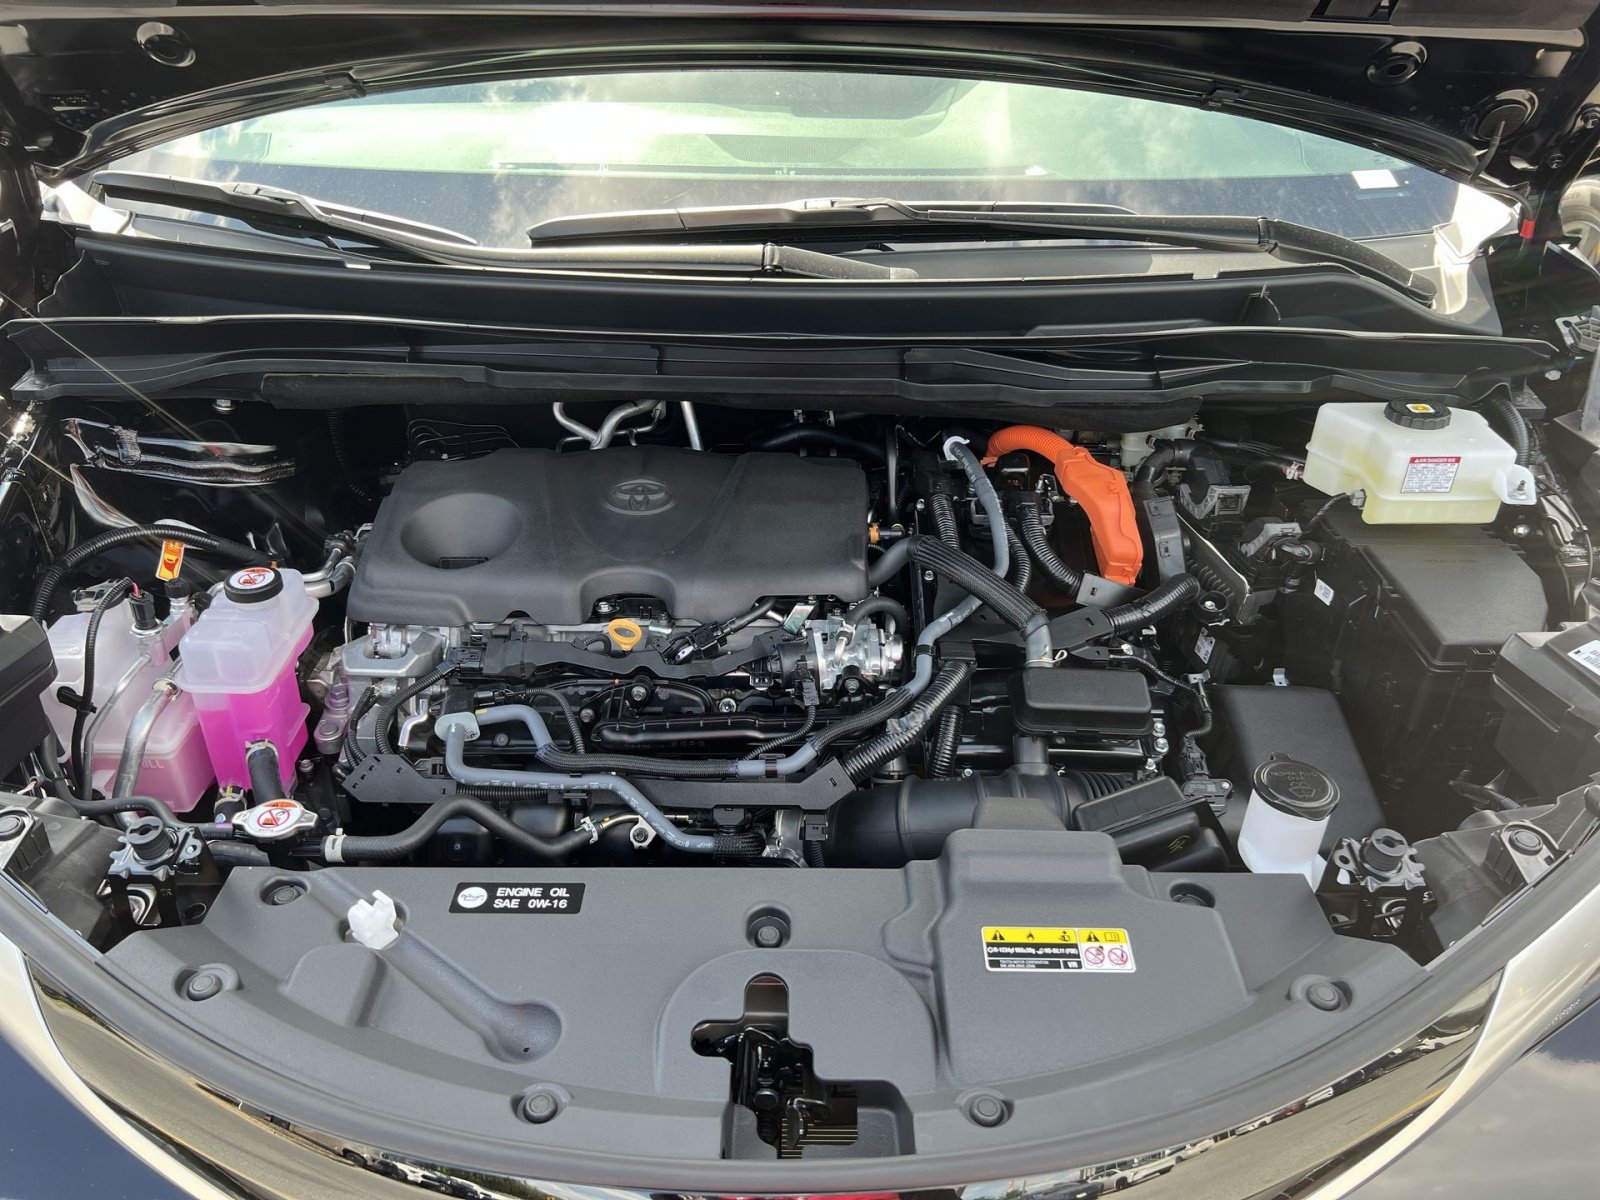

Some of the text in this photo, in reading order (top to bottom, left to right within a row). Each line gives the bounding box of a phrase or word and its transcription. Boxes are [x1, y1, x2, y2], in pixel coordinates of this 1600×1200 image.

[496, 887, 570, 897] ENGINE OIL
[493, 898, 568, 908] SAE 0W-16
